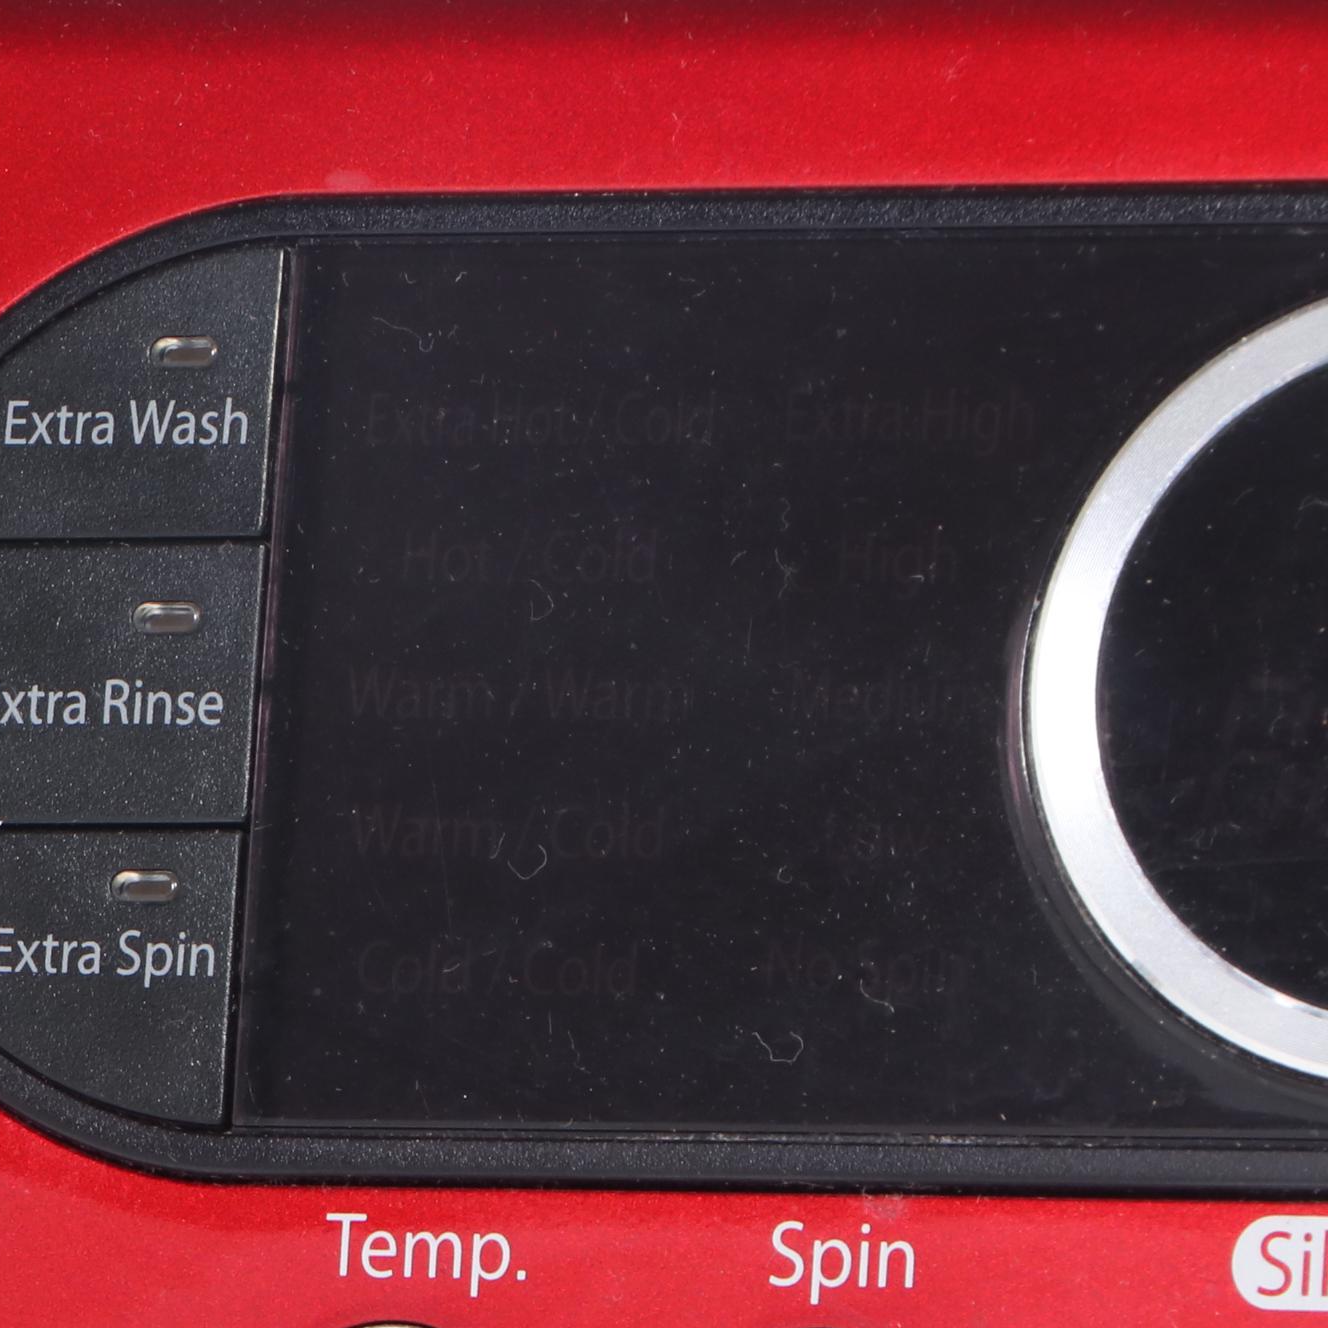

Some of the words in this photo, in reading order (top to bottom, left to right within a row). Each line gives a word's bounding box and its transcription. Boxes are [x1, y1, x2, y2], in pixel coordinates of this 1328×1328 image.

[3, 400, 114, 446] Extra
[130, 399, 249, 446] Wash
[102, 679, 223, 726] Rinse
[118, 930, 215, 988] Spin
[325, 1213, 528, 1298] Temp.
[769, 1221, 916, 1304] Spin
